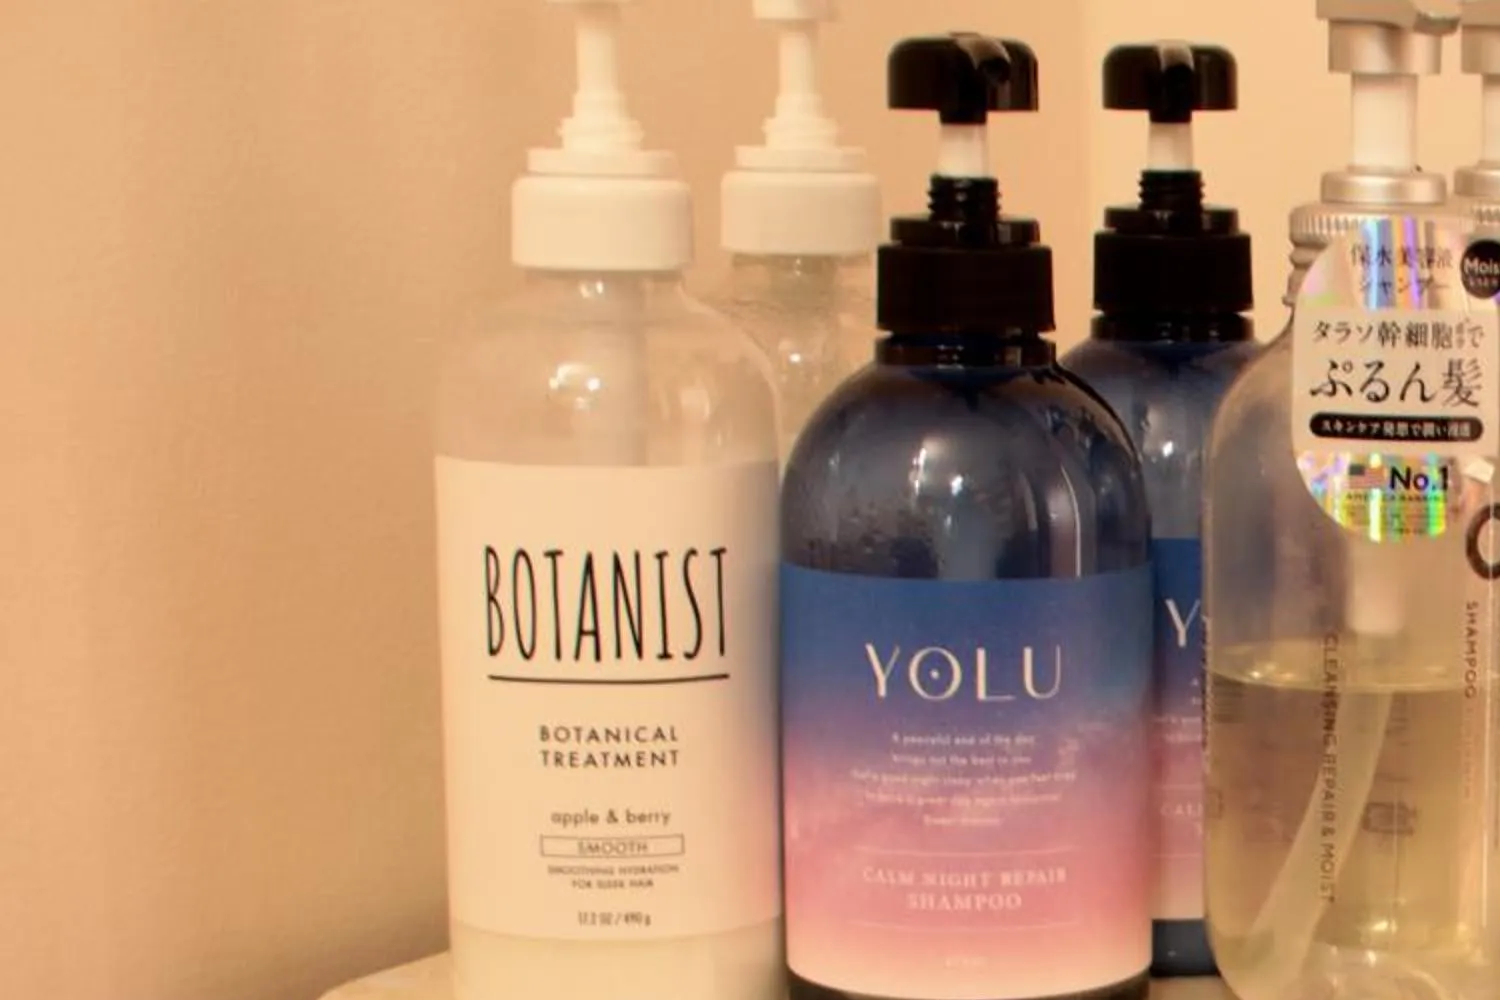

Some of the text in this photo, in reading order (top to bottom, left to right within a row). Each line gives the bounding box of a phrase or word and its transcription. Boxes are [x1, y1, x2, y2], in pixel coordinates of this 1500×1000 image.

[1309, 357, 1482, 408] ぷるん髪
[1389, 464, 1450, 491] No.1
[484, 544, 729, 662] BOTANIST
[1464, 601, 1479, 699] SHAMPOO
[865, 642, 1063, 702] YOLU
[538, 724, 680, 744] BOTANICAL
[541, 748, 680, 769] TREATMENT
[550, 808, 672, 829] apple & berry
[577, 841, 649, 856] SMOOTH
[862, 865, 1068, 889] CALM NIGHT REPAIR
[1320, 841, 1336, 904] MOIST
[906, 891, 1024, 912] SHAMPOO
